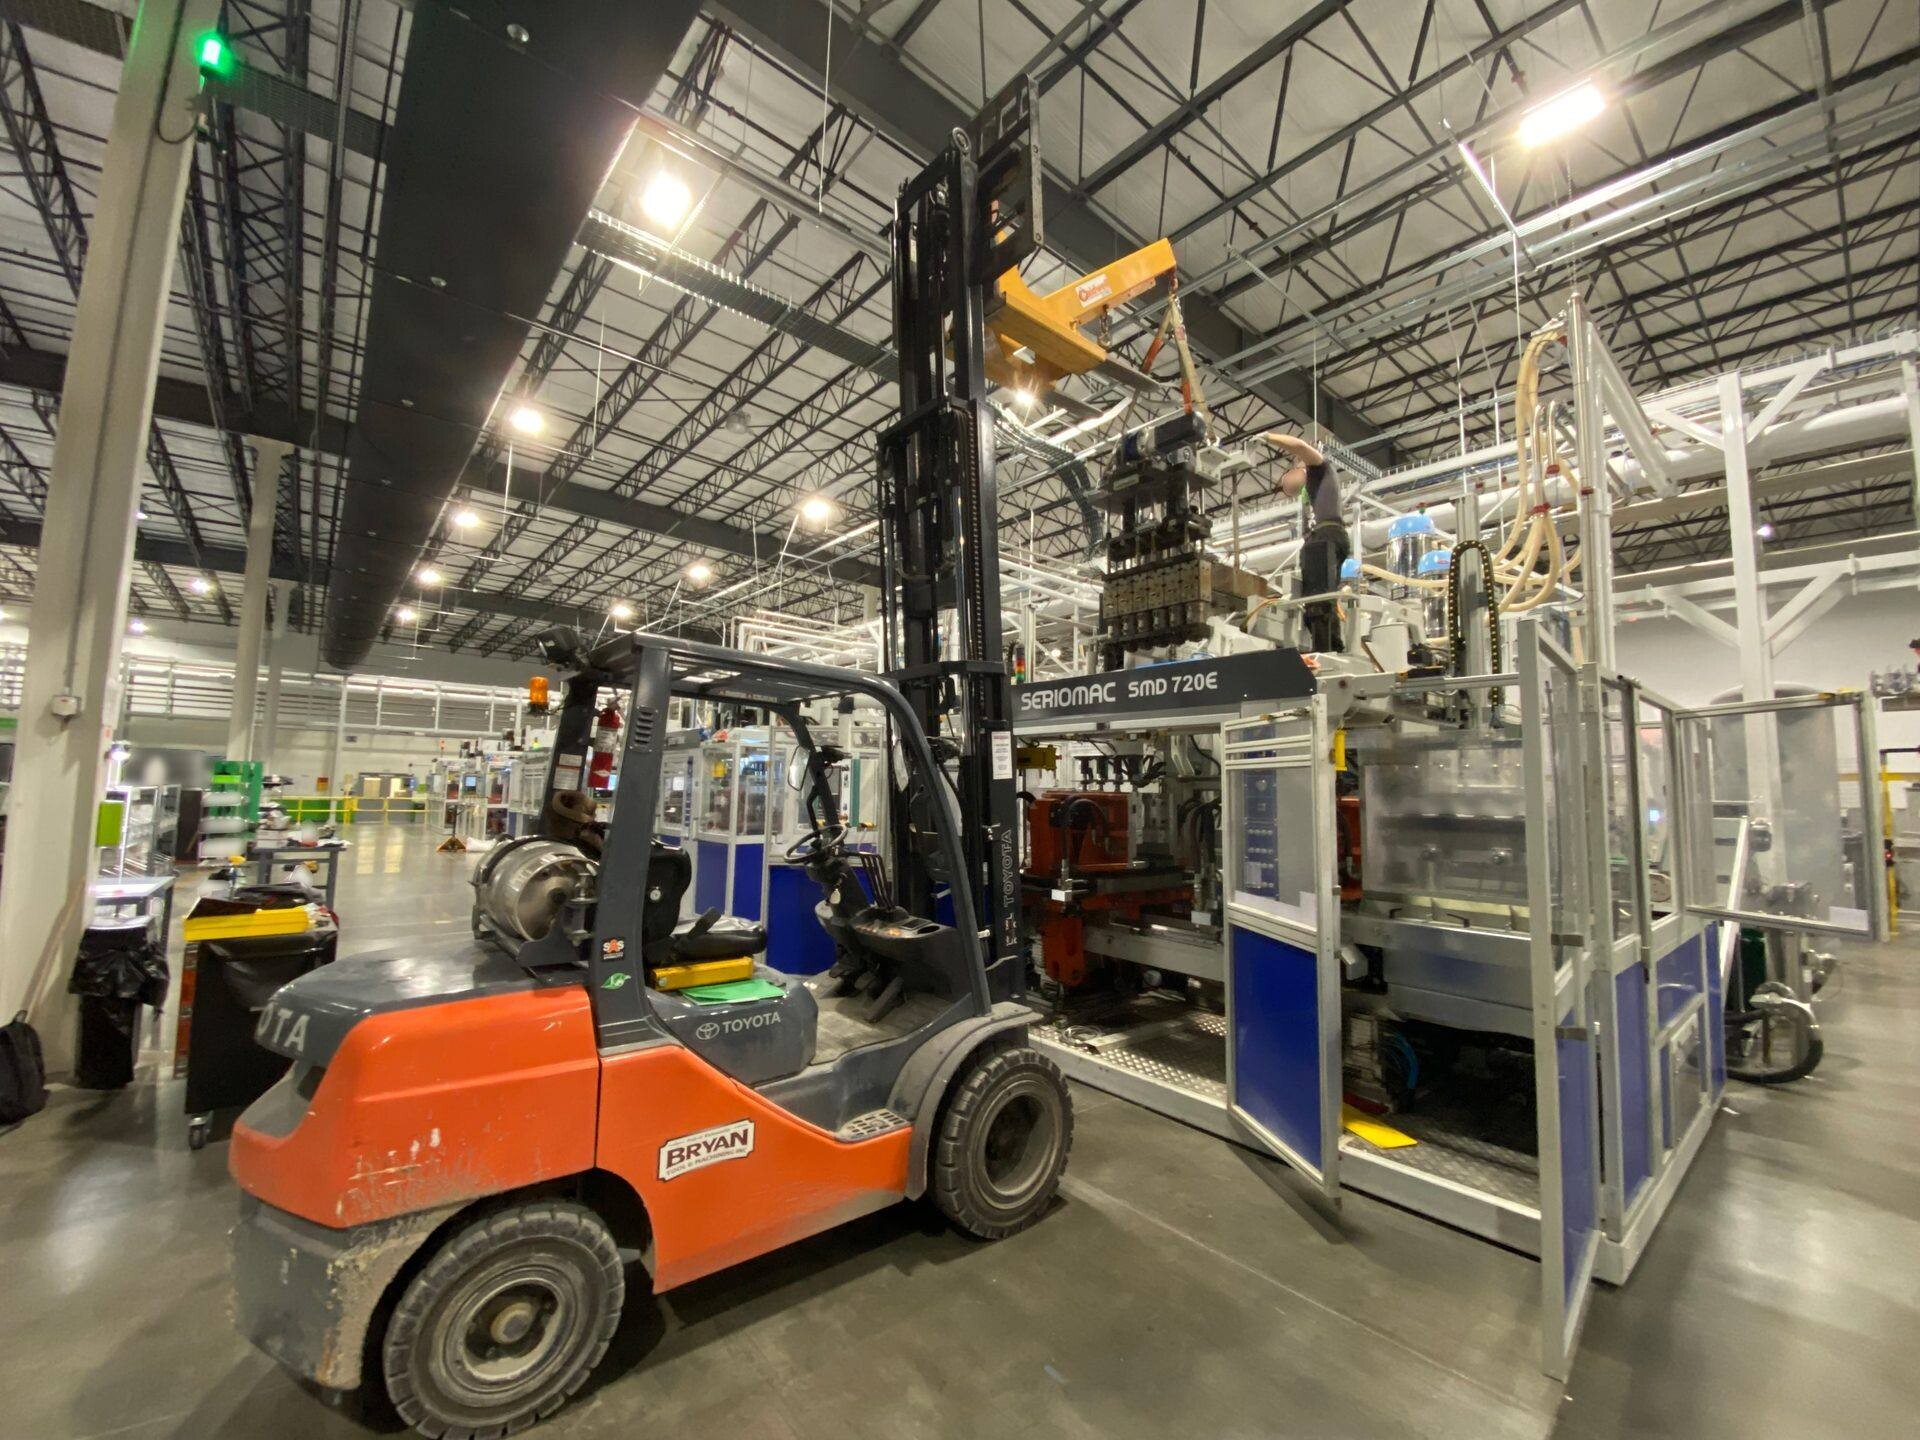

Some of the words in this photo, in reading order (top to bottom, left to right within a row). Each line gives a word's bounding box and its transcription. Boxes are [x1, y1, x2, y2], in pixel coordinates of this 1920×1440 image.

[1021, 682, 1116, 711] SERIOMAC
[1128, 678, 1168, 698] SMD
[1171, 671, 1218, 693] 720E
[1002, 829, 1014, 908] TOYOTA
[722, 1011, 781, 1034] TOYOTA
[666, 1128, 749, 1169] BRYAN
